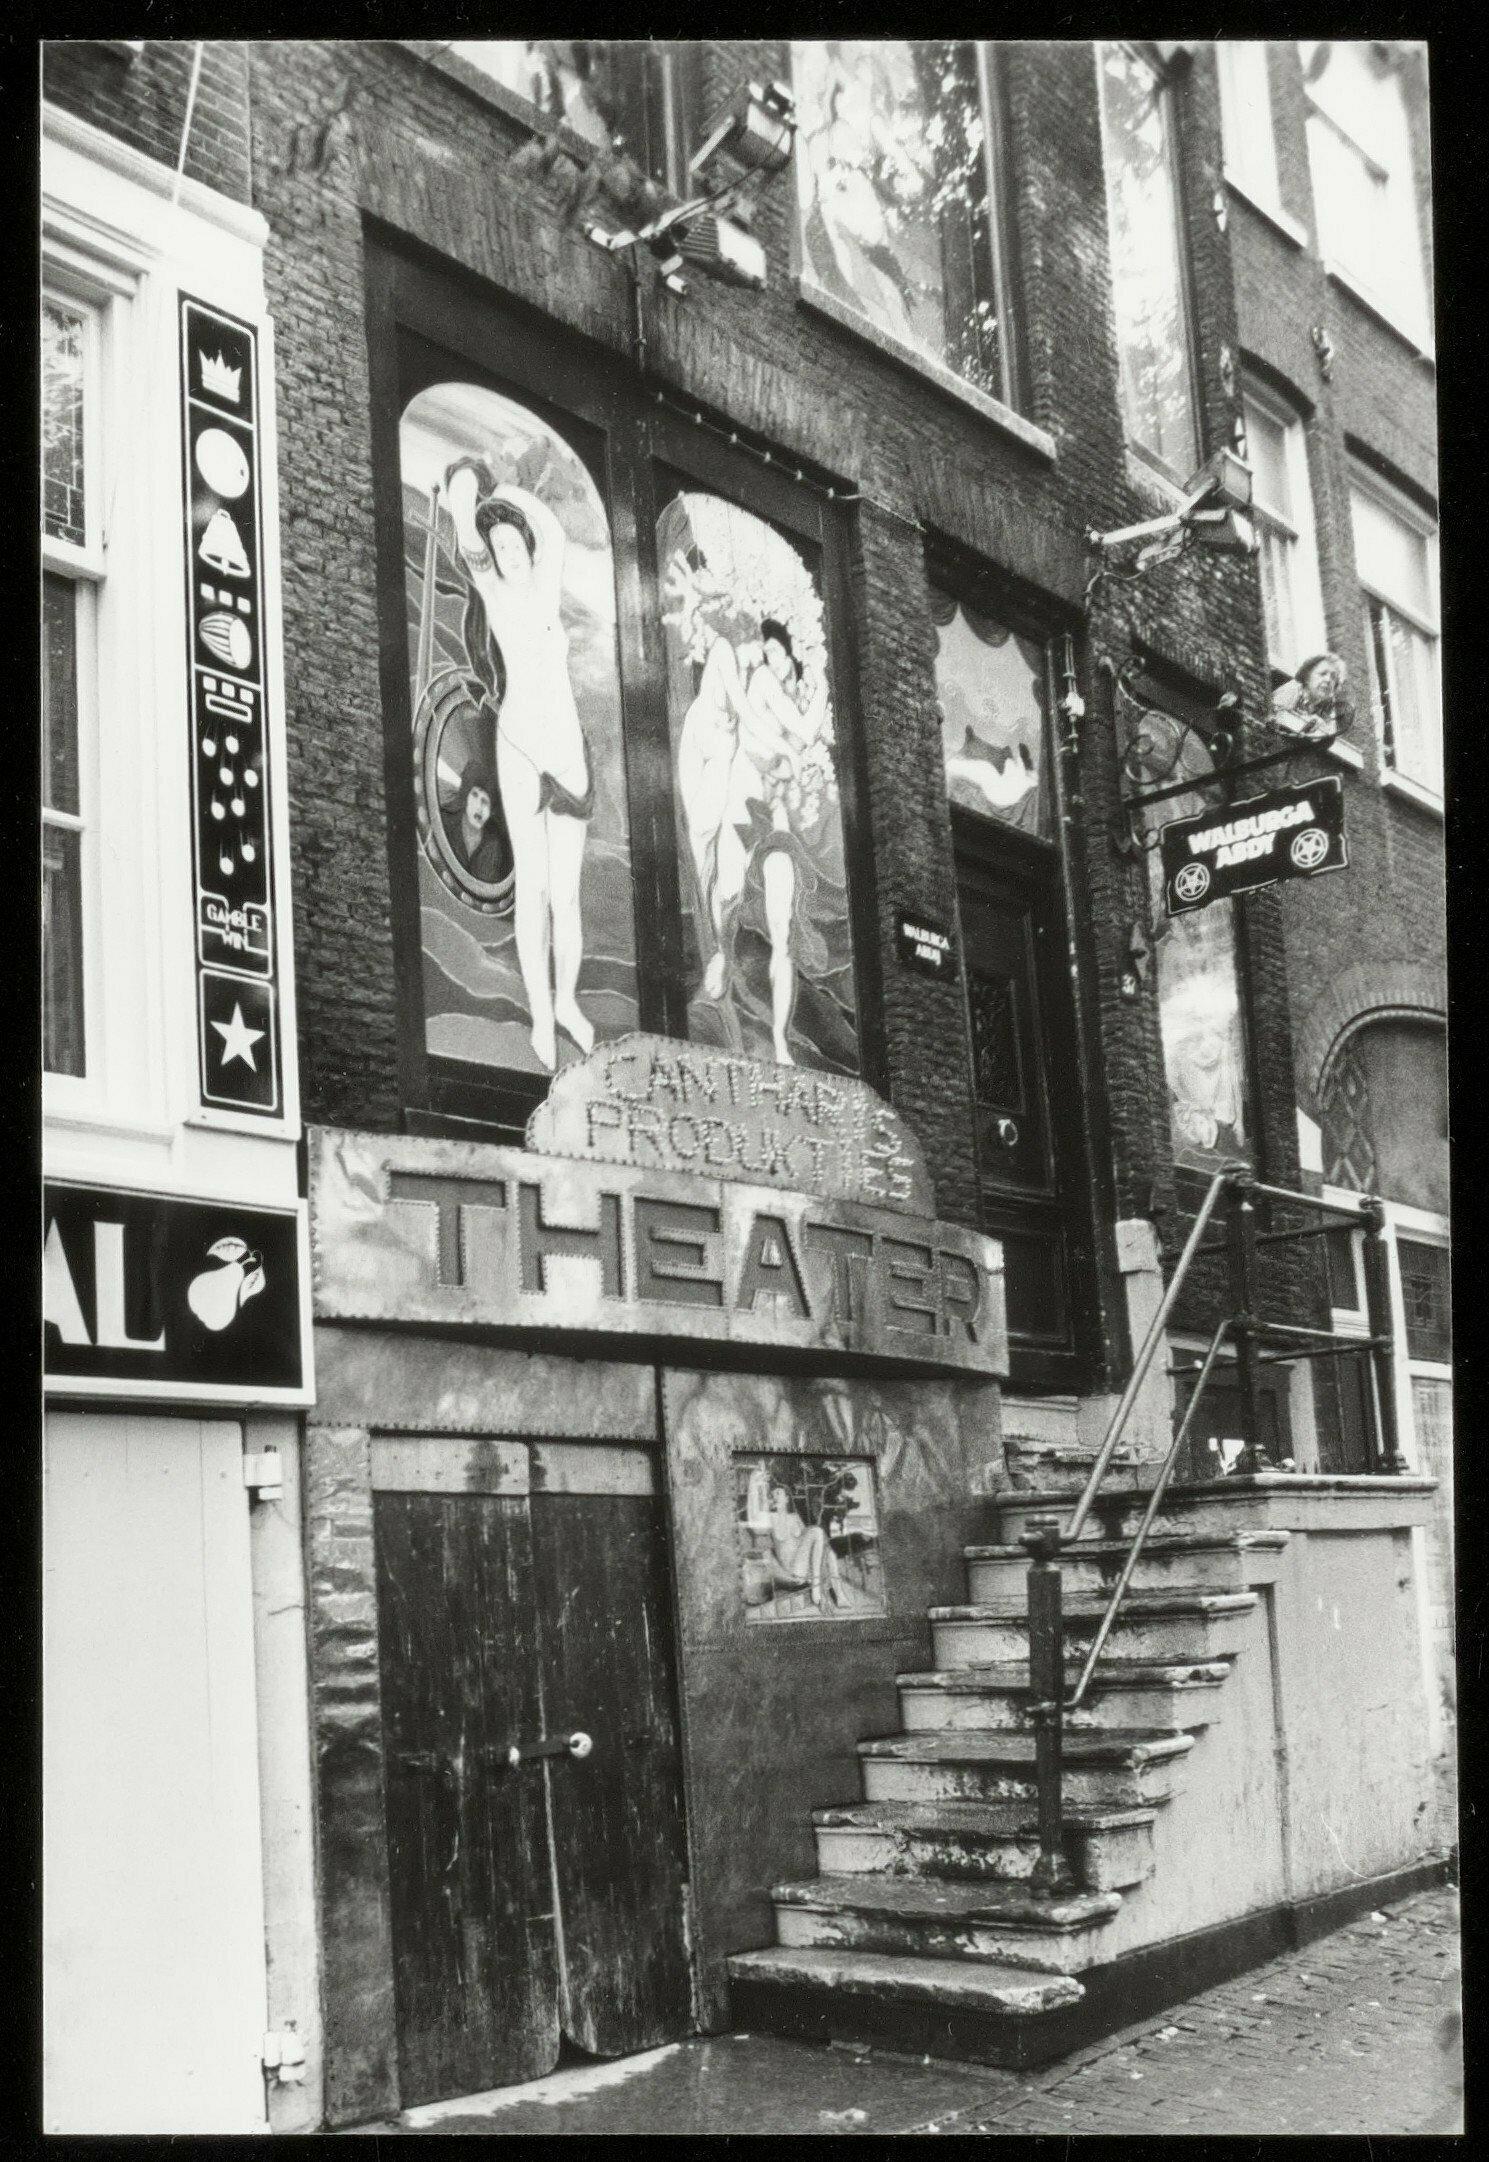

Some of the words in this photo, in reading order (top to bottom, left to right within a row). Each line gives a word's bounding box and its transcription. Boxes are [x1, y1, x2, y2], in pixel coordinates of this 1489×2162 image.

[1188, 801, 1314, 854] WALBURGA
[586, 1099, 915, 1200] PRODUKTIES
[604, 1046, 902, 1157] CANTHARIS
[384, 1166, 985, 1343] THEATER
